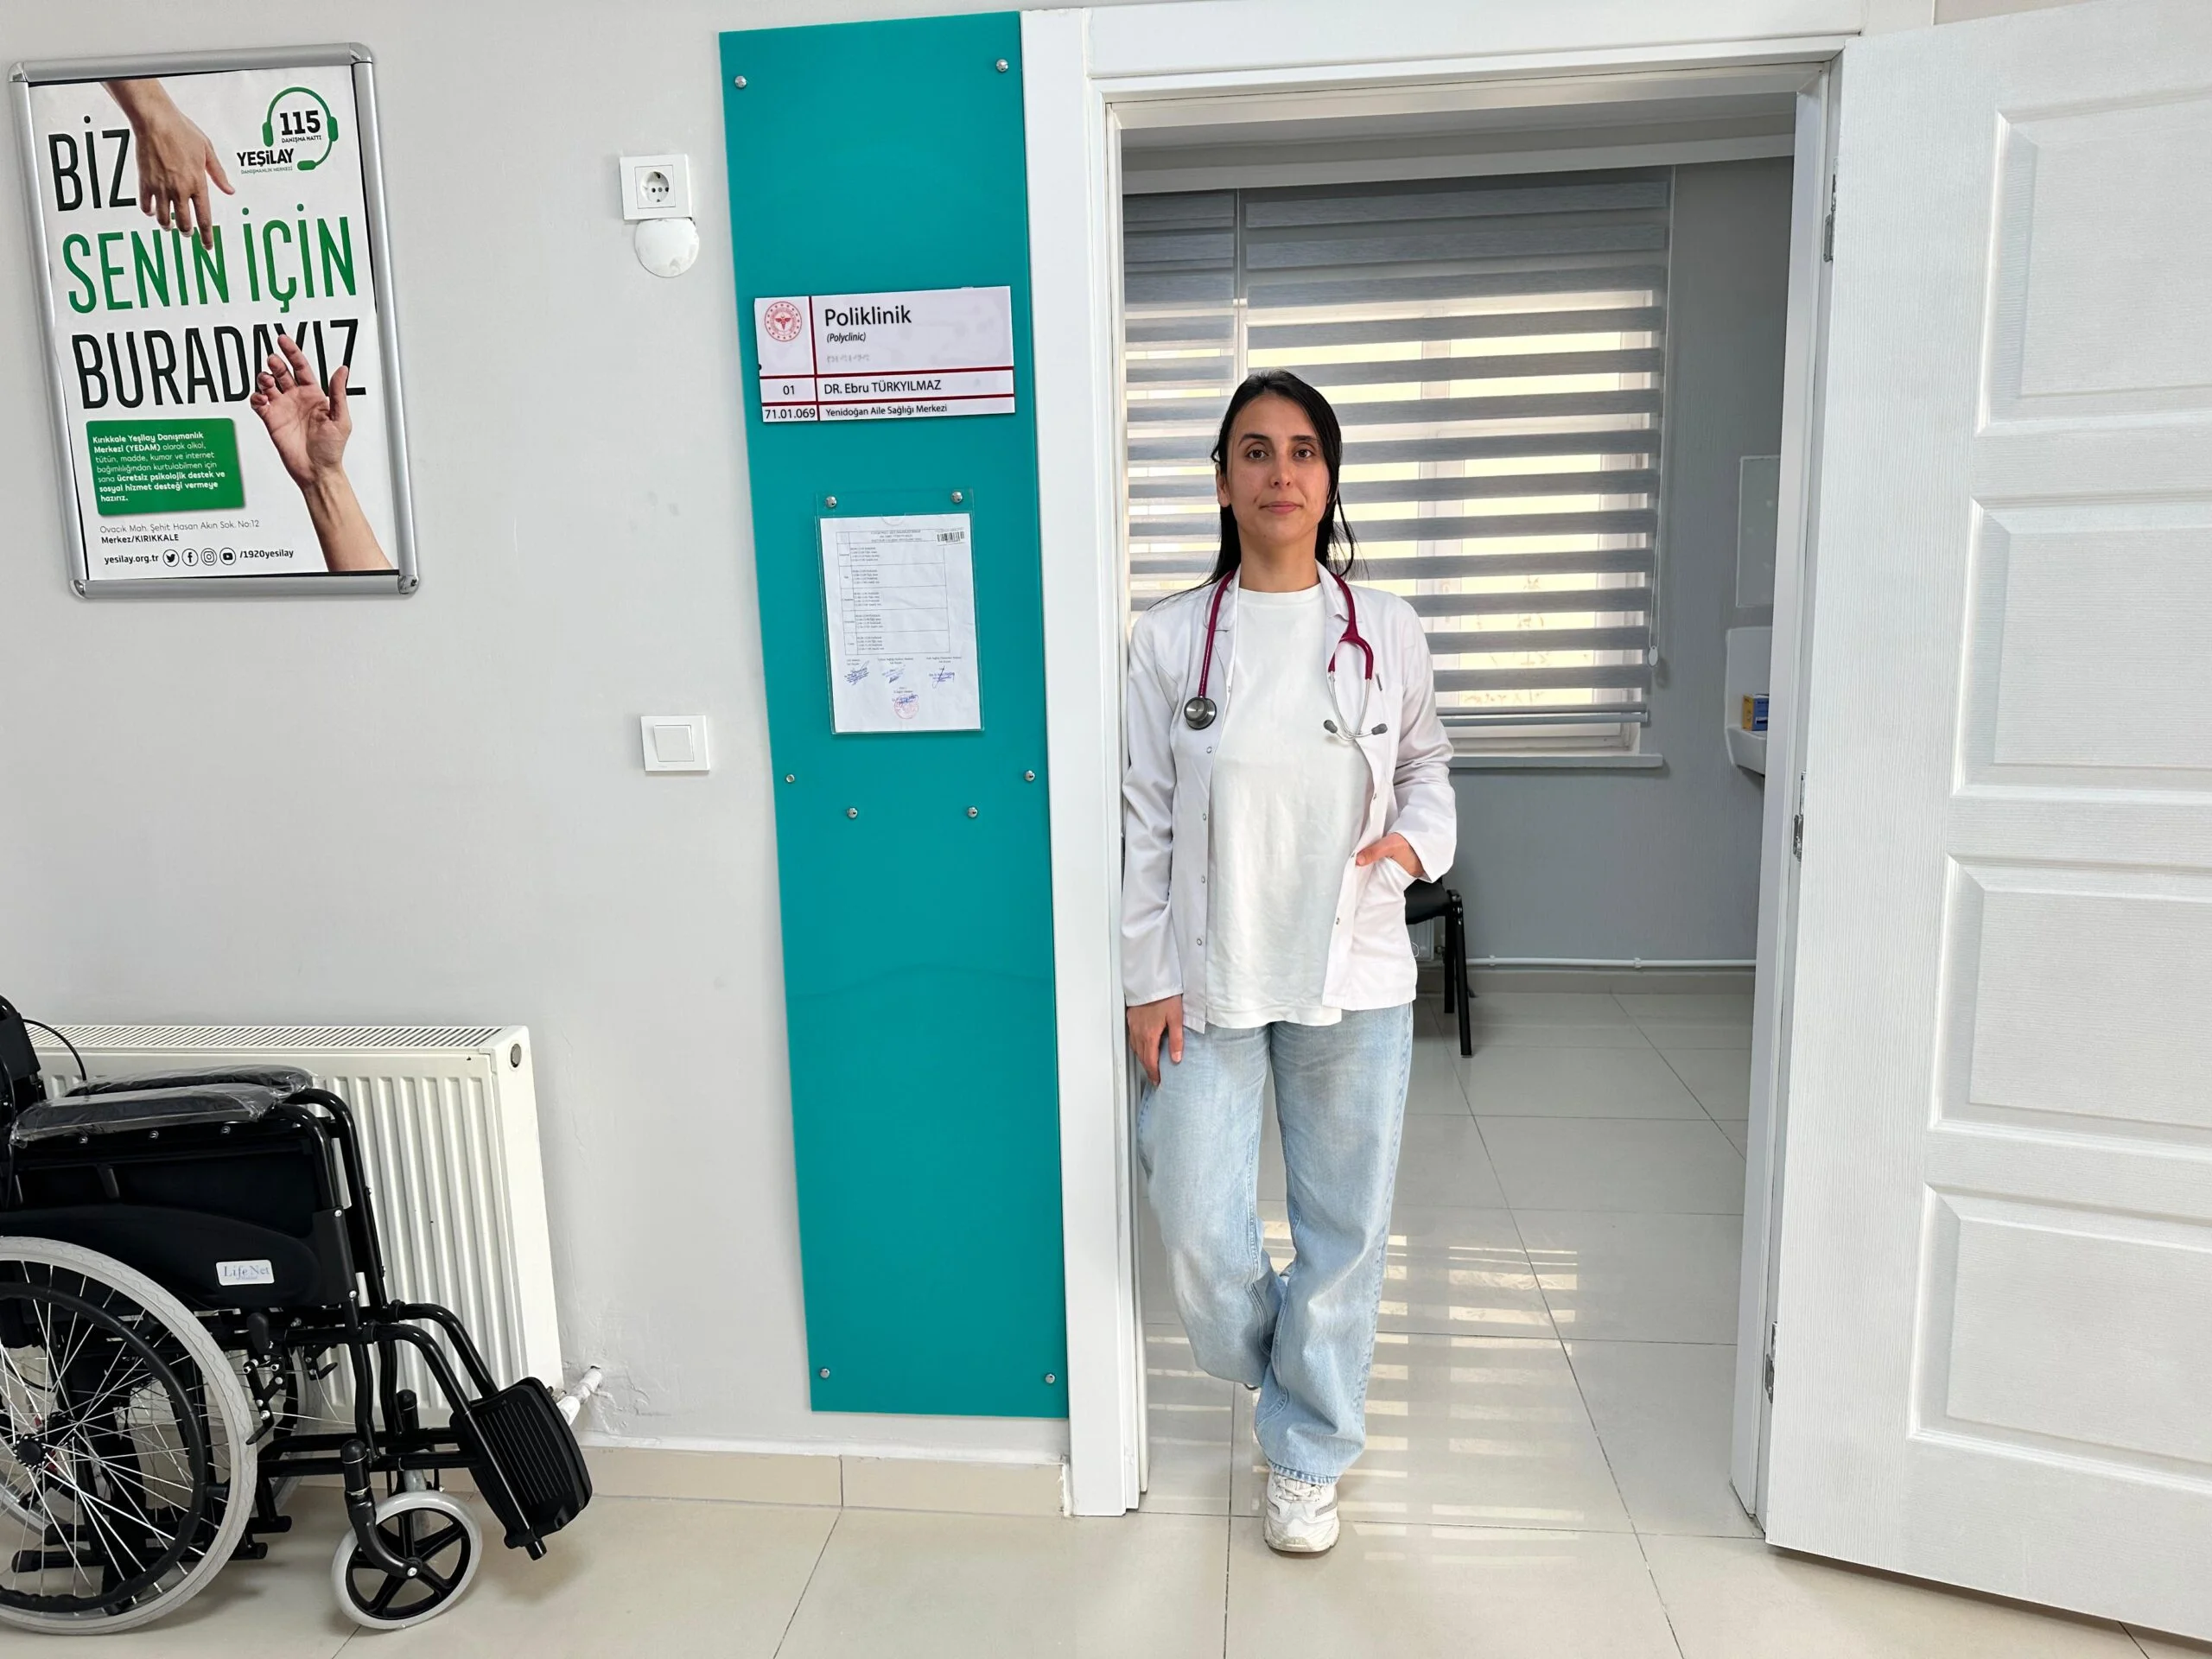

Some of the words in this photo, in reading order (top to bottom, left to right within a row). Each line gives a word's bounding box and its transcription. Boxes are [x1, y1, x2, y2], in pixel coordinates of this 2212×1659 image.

[280, 111, 321, 136] 115
[48, 115, 137, 212] BİZ
[62, 209, 230, 314] SENİN
[242, 203, 356, 313] İÇİN
[825, 305, 912, 327] Poliklinik
[827, 332, 866, 343] (Polyclinic)
[783, 385, 795, 395] 01
[824, 384, 842, 395] DR.
[845, 382, 869, 393] Ebru
[873, 379, 941, 392] TÜRKYILMAZ
[765, 408, 816, 420] 71.01.069
[826, 407, 868, 416] Yenidoğan
[871, 406, 886, 415] Aile
[888, 405, 914, 416] Sağlığı
[916, 404, 947, 413] Merkezi
[128, 434, 156, 443] Yeşilay
[158, 432, 203, 442] Danışmanlık
[153, 462, 202, 471] kurtulabilmen
[150, 473, 186, 482] psikolojik
[99, 485, 123, 493] sosyal
[154, 482, 182, 491] desteği
[150, 524, 170, 532] Şehit
[174, 523, 199, 531] Hasan
[238, 519, 259, 529] No:12
[101, 534, 179, 544] Merkez/KIRIKKALE
[105, 554, 159, 565] yesilay.org.tr
[240, 550, 294, 559] /1920yesilay
[224, 1265, 248, 1278] Life
[250, 1265, 270, 1274] Net
